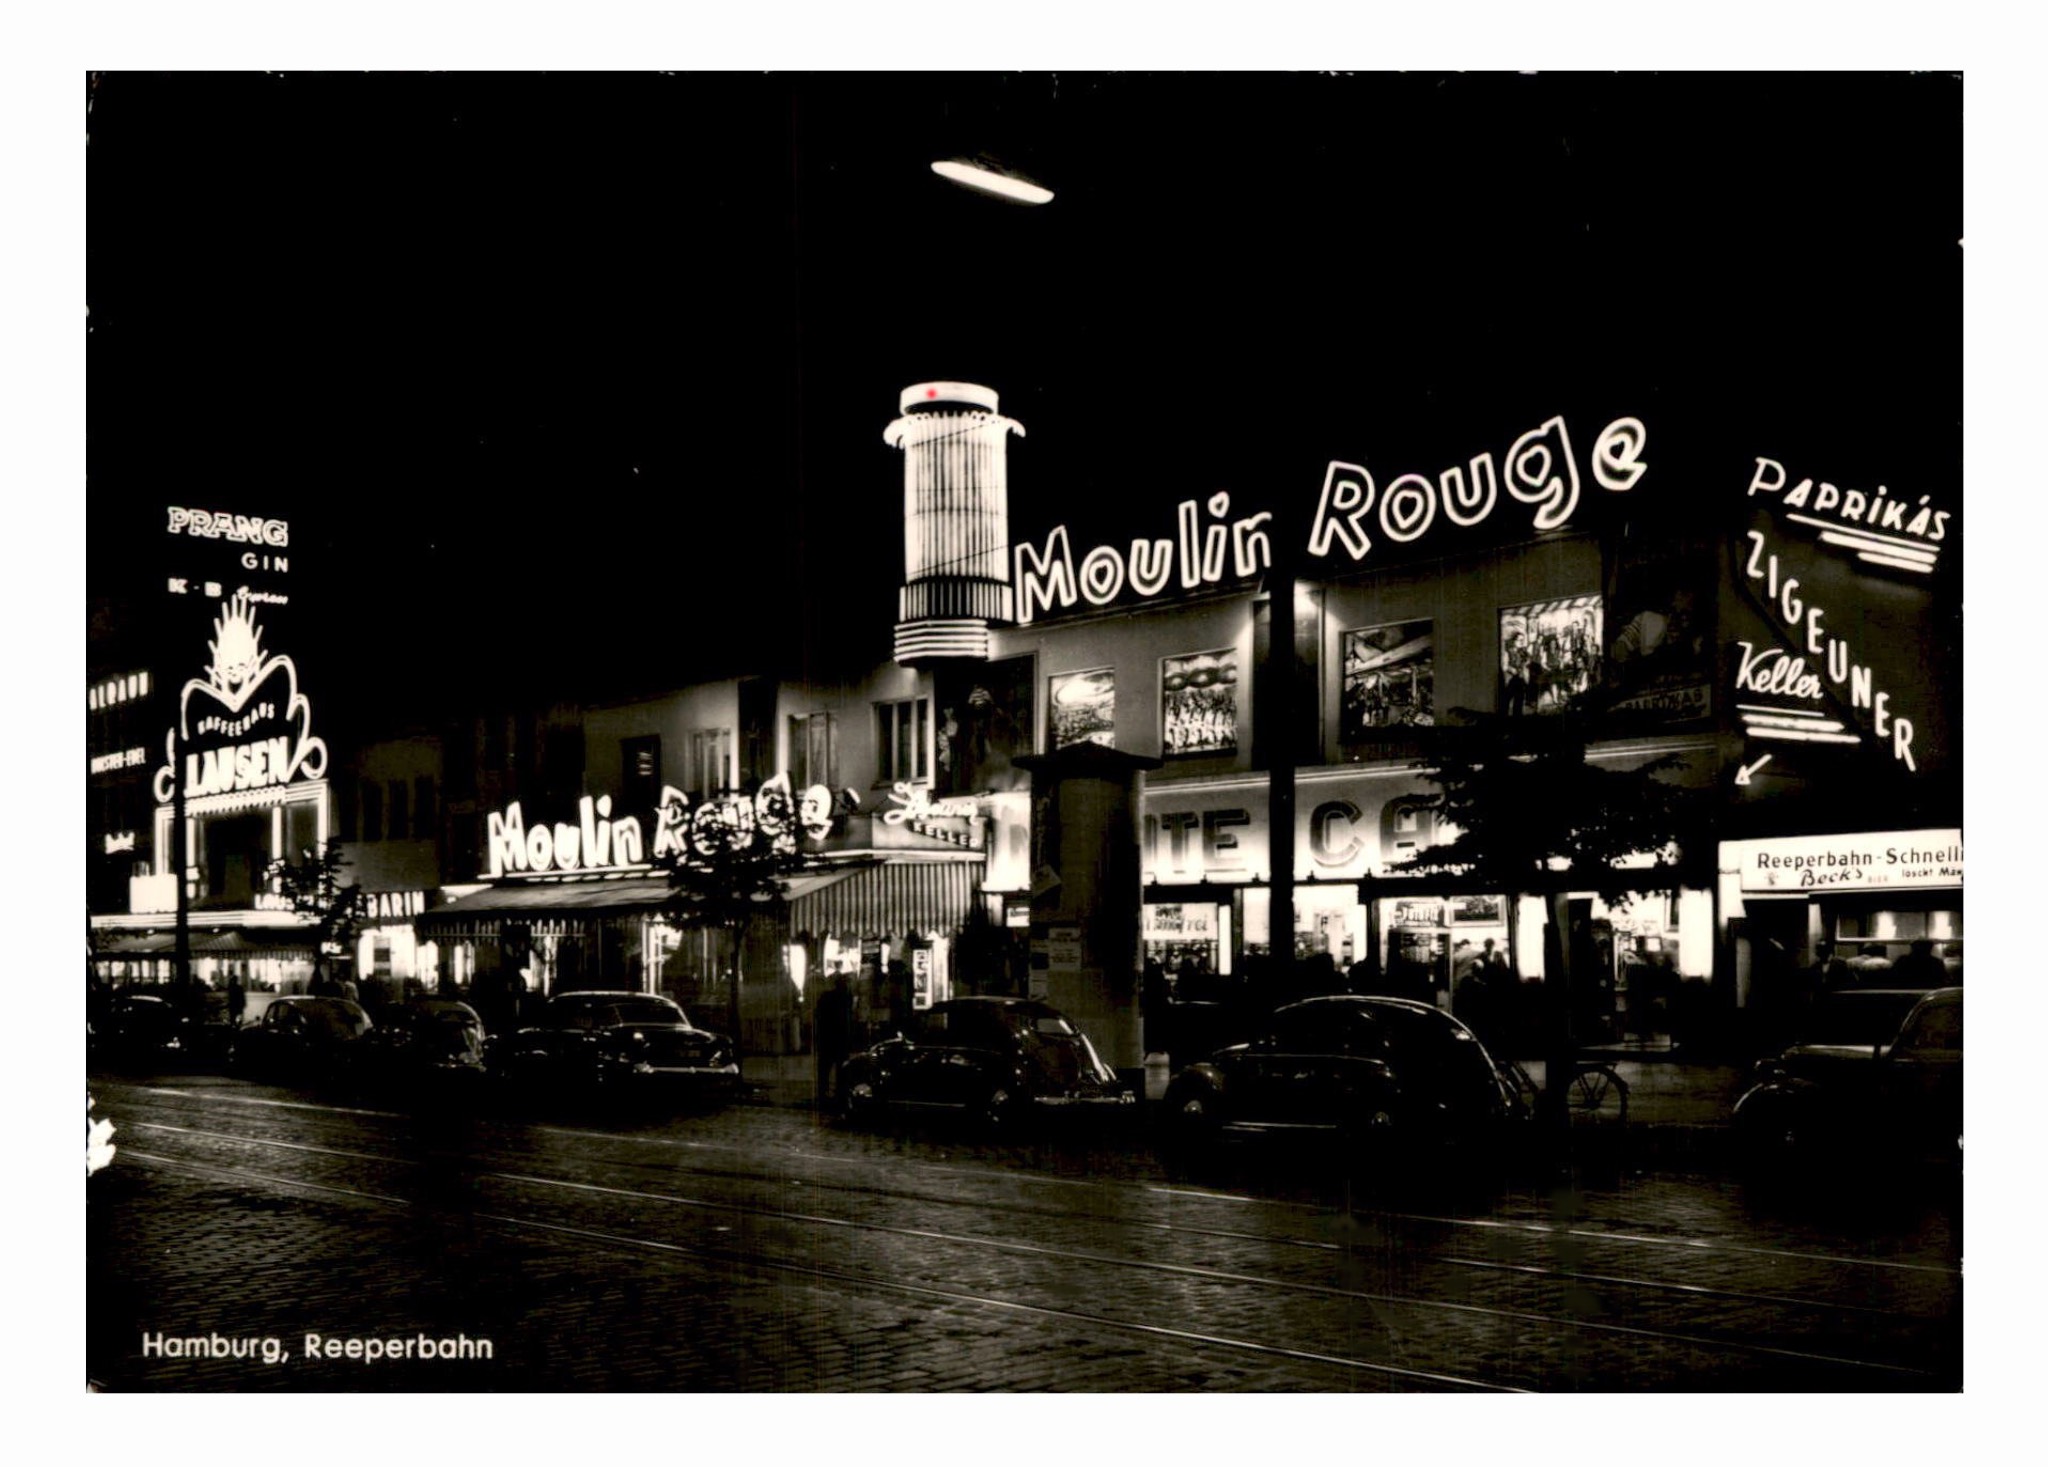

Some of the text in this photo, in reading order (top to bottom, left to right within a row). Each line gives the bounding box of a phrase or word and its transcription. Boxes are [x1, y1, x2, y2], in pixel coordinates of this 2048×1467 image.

[167, 506, 288, 547] PRANG
[1014, 415, 1647, 624] Moulin Rouge
[241, 552, 288, 573] GIN
[1736, 641, 1824, 699] Keller
[1746, 530, 1916, 772] ZIGEUNER
[488, 795, 643, 876] Moulin
[1800, 867, 1863, 887] Beck's
